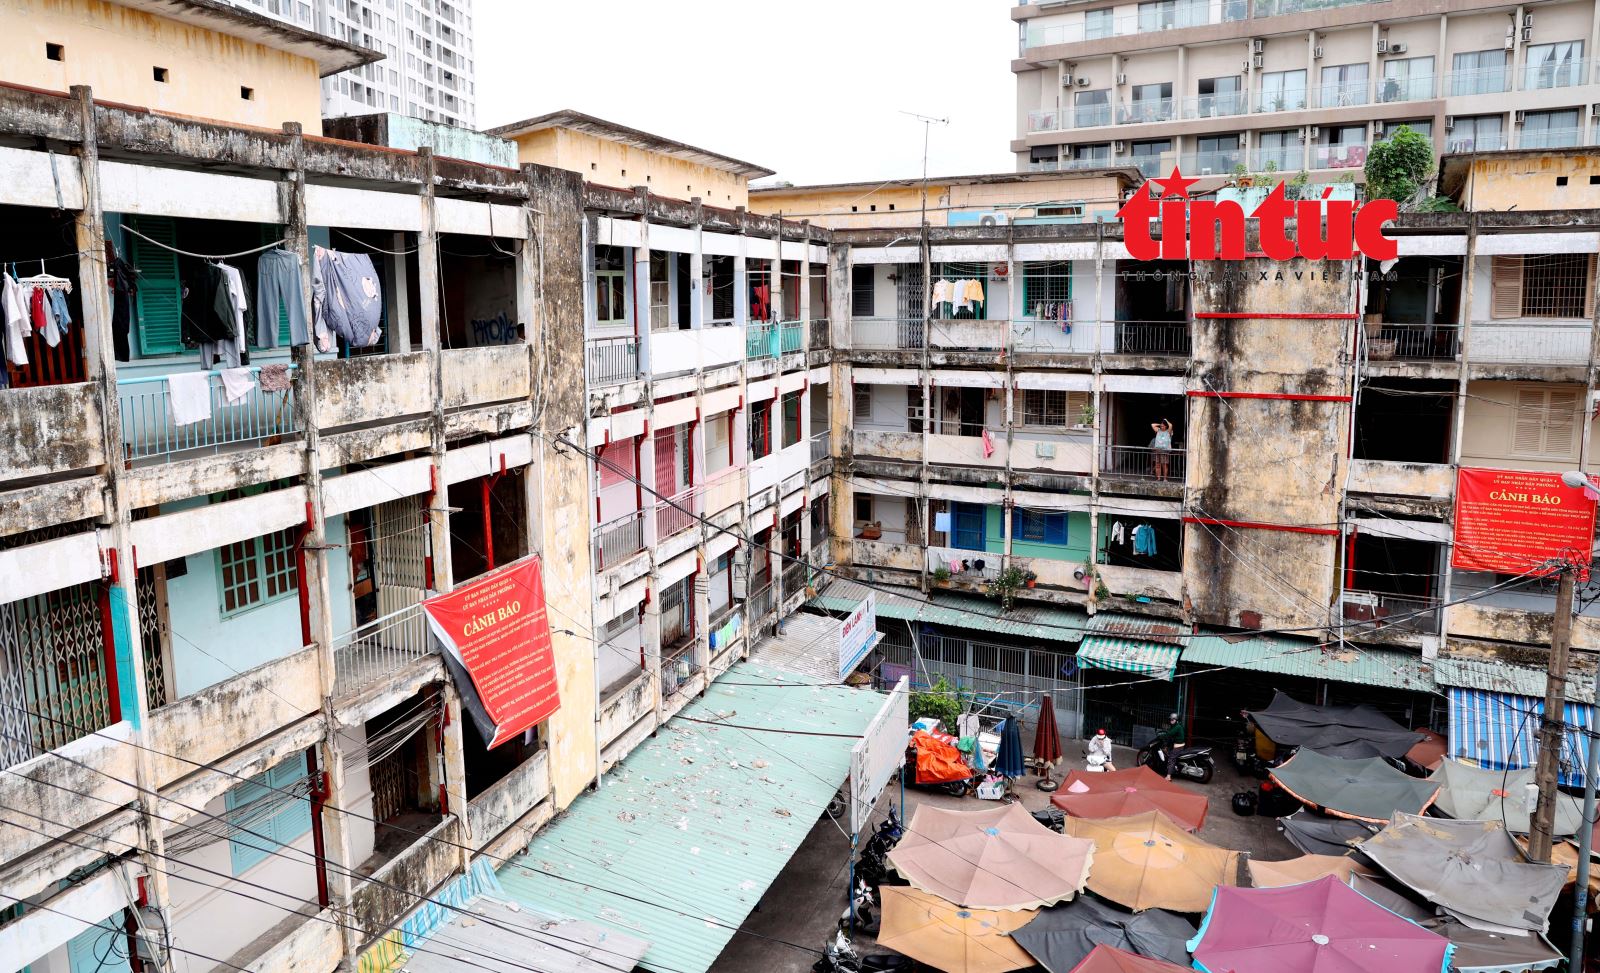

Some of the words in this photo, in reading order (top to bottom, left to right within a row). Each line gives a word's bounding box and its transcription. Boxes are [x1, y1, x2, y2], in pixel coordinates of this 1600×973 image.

[1489, 488, 1528, 502] CẢNH
[1531, 492, 1561, 505] BÁO
[463, 614, 497, 637] CẢNH
[497, 600, 521, 621] BÁO
